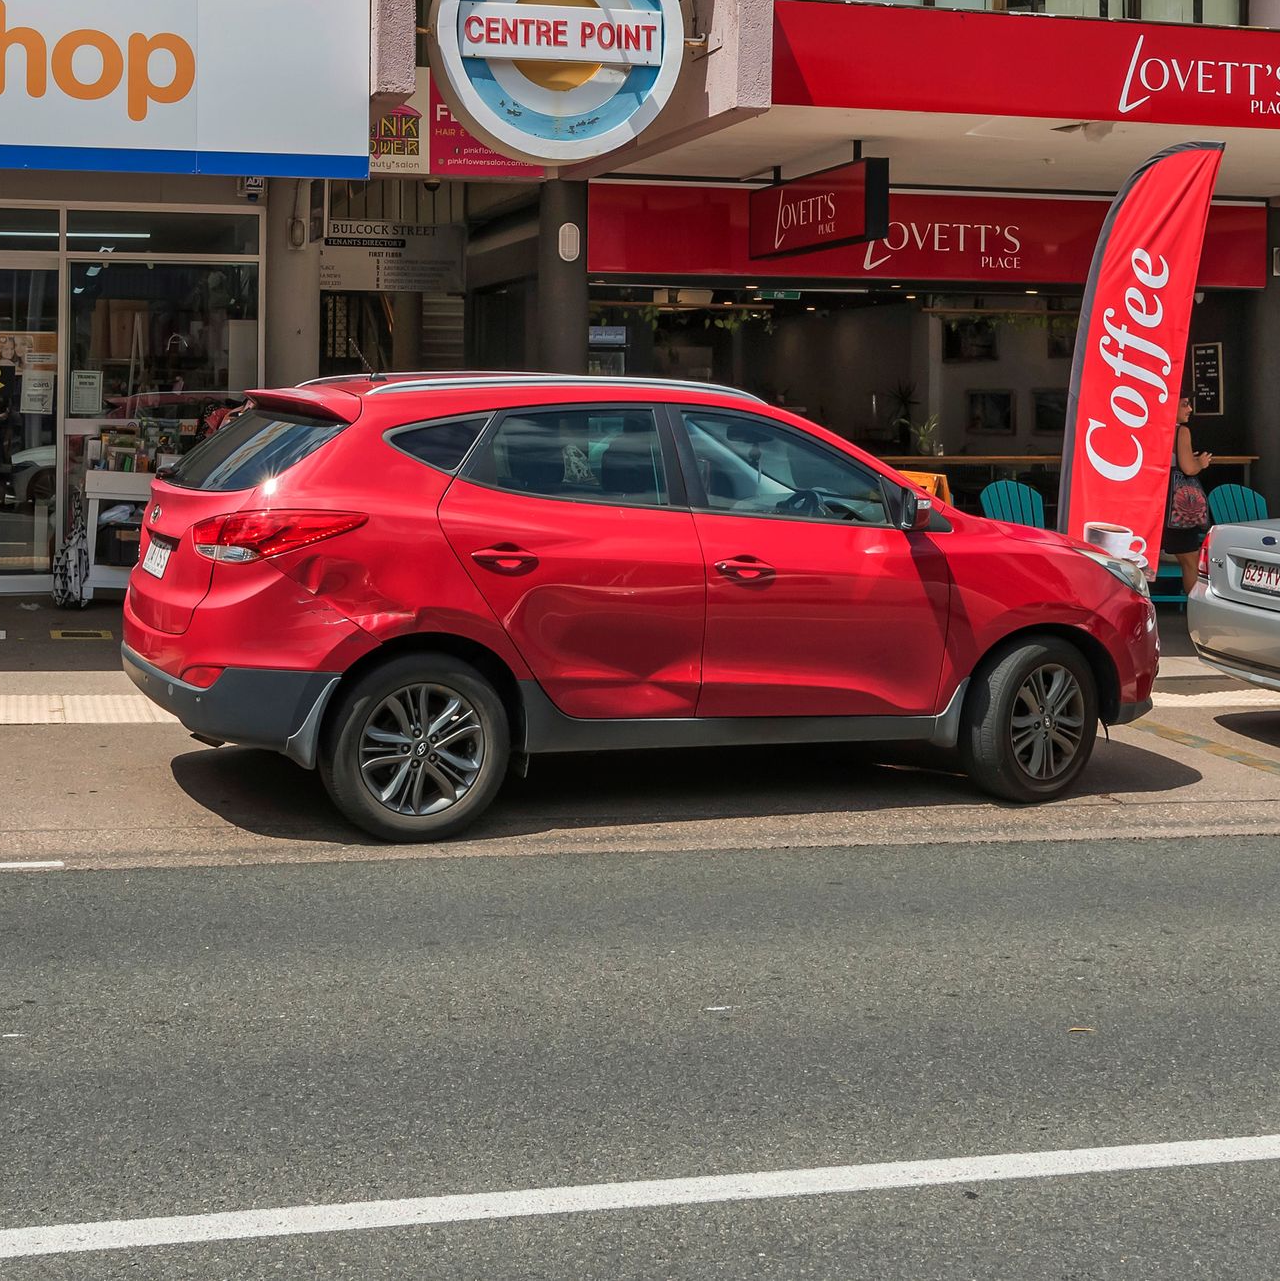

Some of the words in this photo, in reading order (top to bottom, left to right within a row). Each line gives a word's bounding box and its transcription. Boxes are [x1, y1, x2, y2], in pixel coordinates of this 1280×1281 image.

[464, 15, 568, 47] CENTRE
[579, 21, 658, 51] POINT
[435, 128, 456, 136] HAIR
[247, 177, 262, 186] ADT
[774, 189, 835, 249] LOVETT'S
[332, 224, 389, 235] BULCOCK
[392, 225, 438, 236] STREET
[818, 221, 835, 235] PLACE
[328, 238, 361, 246] TENANTS
[362, 239, 403, 247] DIRECTORY
[981, 256, 1020, 269] PLACE
[1085, 247, 1171, 481] Coffee
